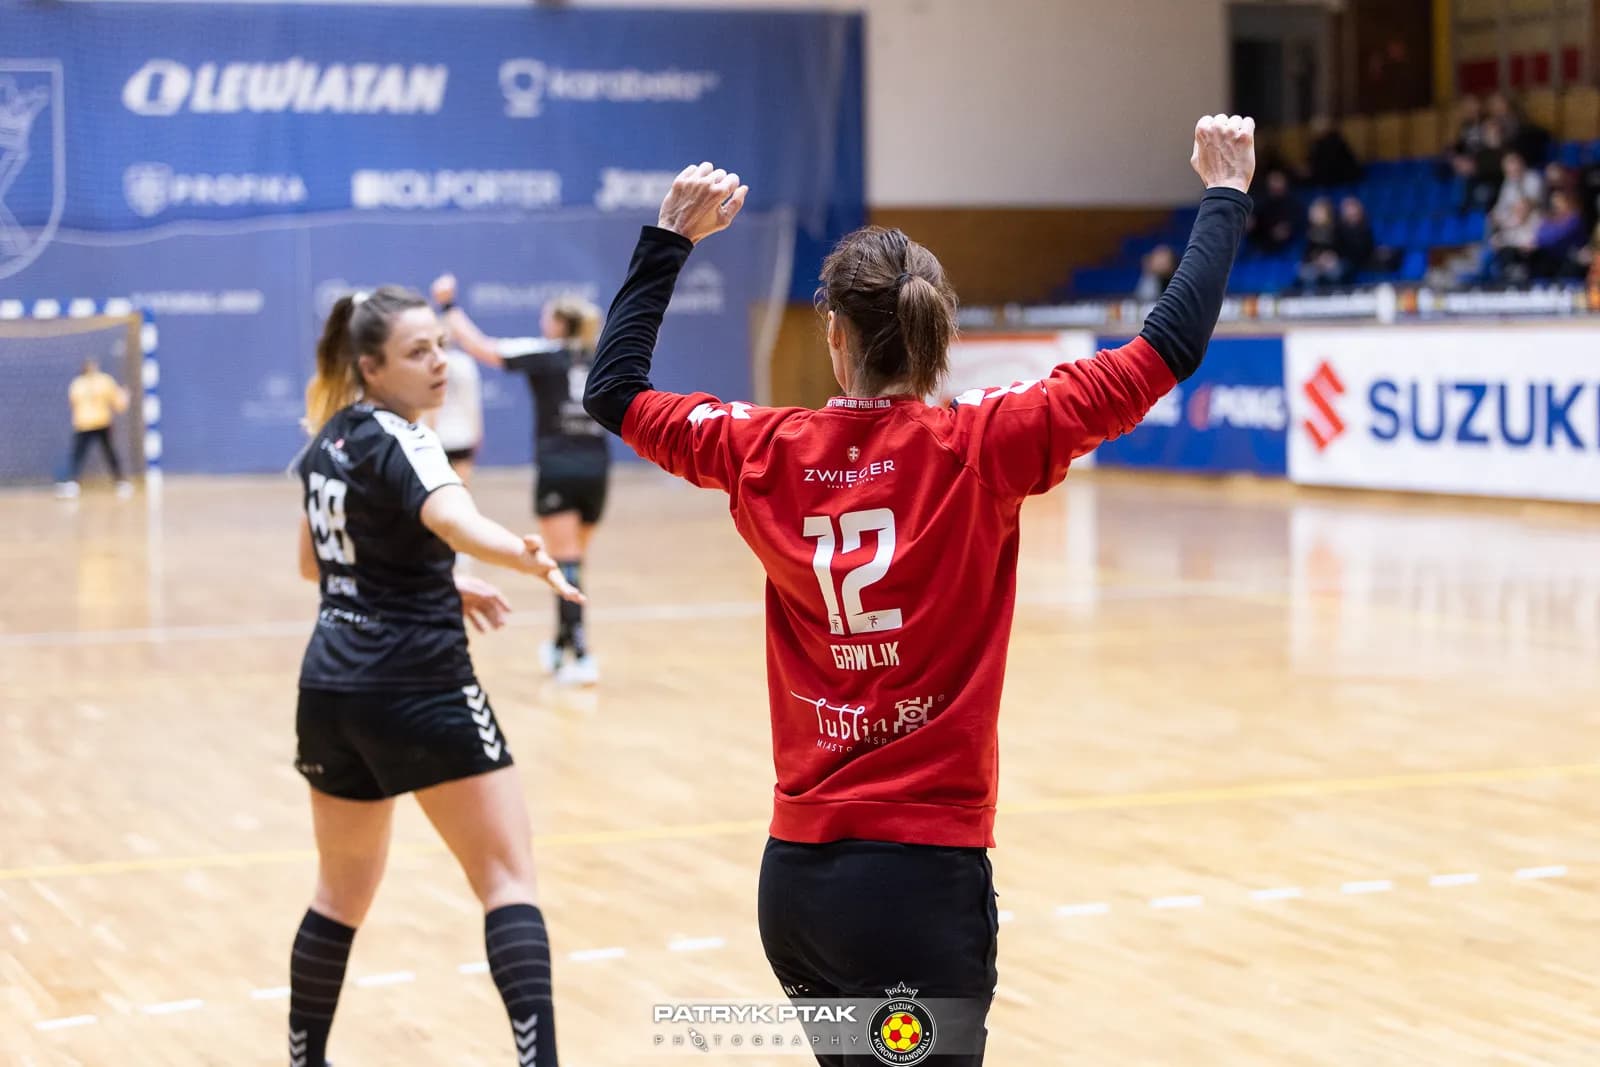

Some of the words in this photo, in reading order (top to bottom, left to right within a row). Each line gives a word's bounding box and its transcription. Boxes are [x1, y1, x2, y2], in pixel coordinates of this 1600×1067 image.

[190, 59, 449, 114] LEWIATAN
[1368, 380, 1600, 449] SUZUK
[803, 460, 895, 482] ZWIEGER
[803, 508, 903, 635] 12
[830, 641, 900, 671] GAWLIK
